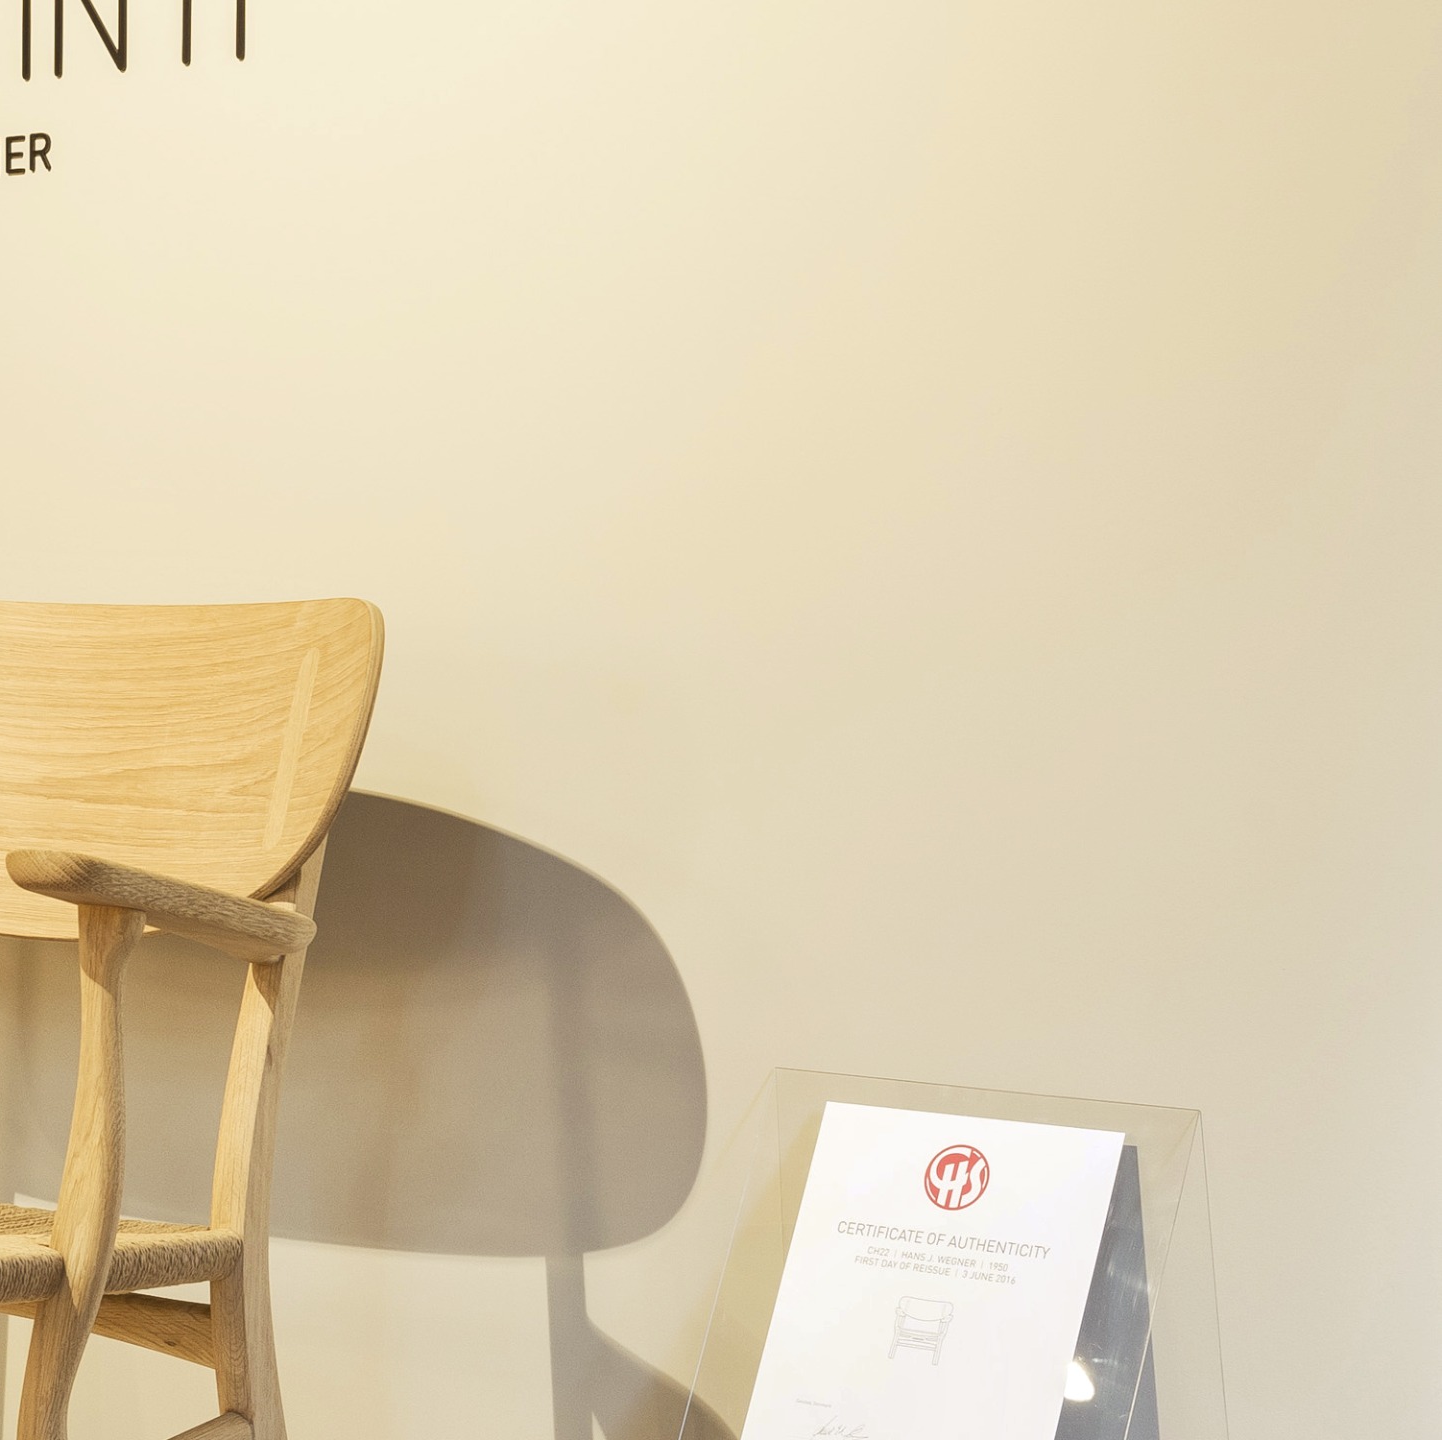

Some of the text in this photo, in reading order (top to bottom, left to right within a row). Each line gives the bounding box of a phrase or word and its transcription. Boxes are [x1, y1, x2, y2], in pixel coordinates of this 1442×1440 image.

[837, 1220, 1050, 1260] CERTIFICATE OF AUTHENTICITY
[854, 1255, 1016, 1285] FIRST DAY OF REISSUE 3 JUNE 2016
[866, 1246, 890, 1257] CH22
[901, 1250, 926, 1262] HANS
[937, 1255, 977, 1268] WEGNER
[988, 1261, 1009, 1272] 1950
